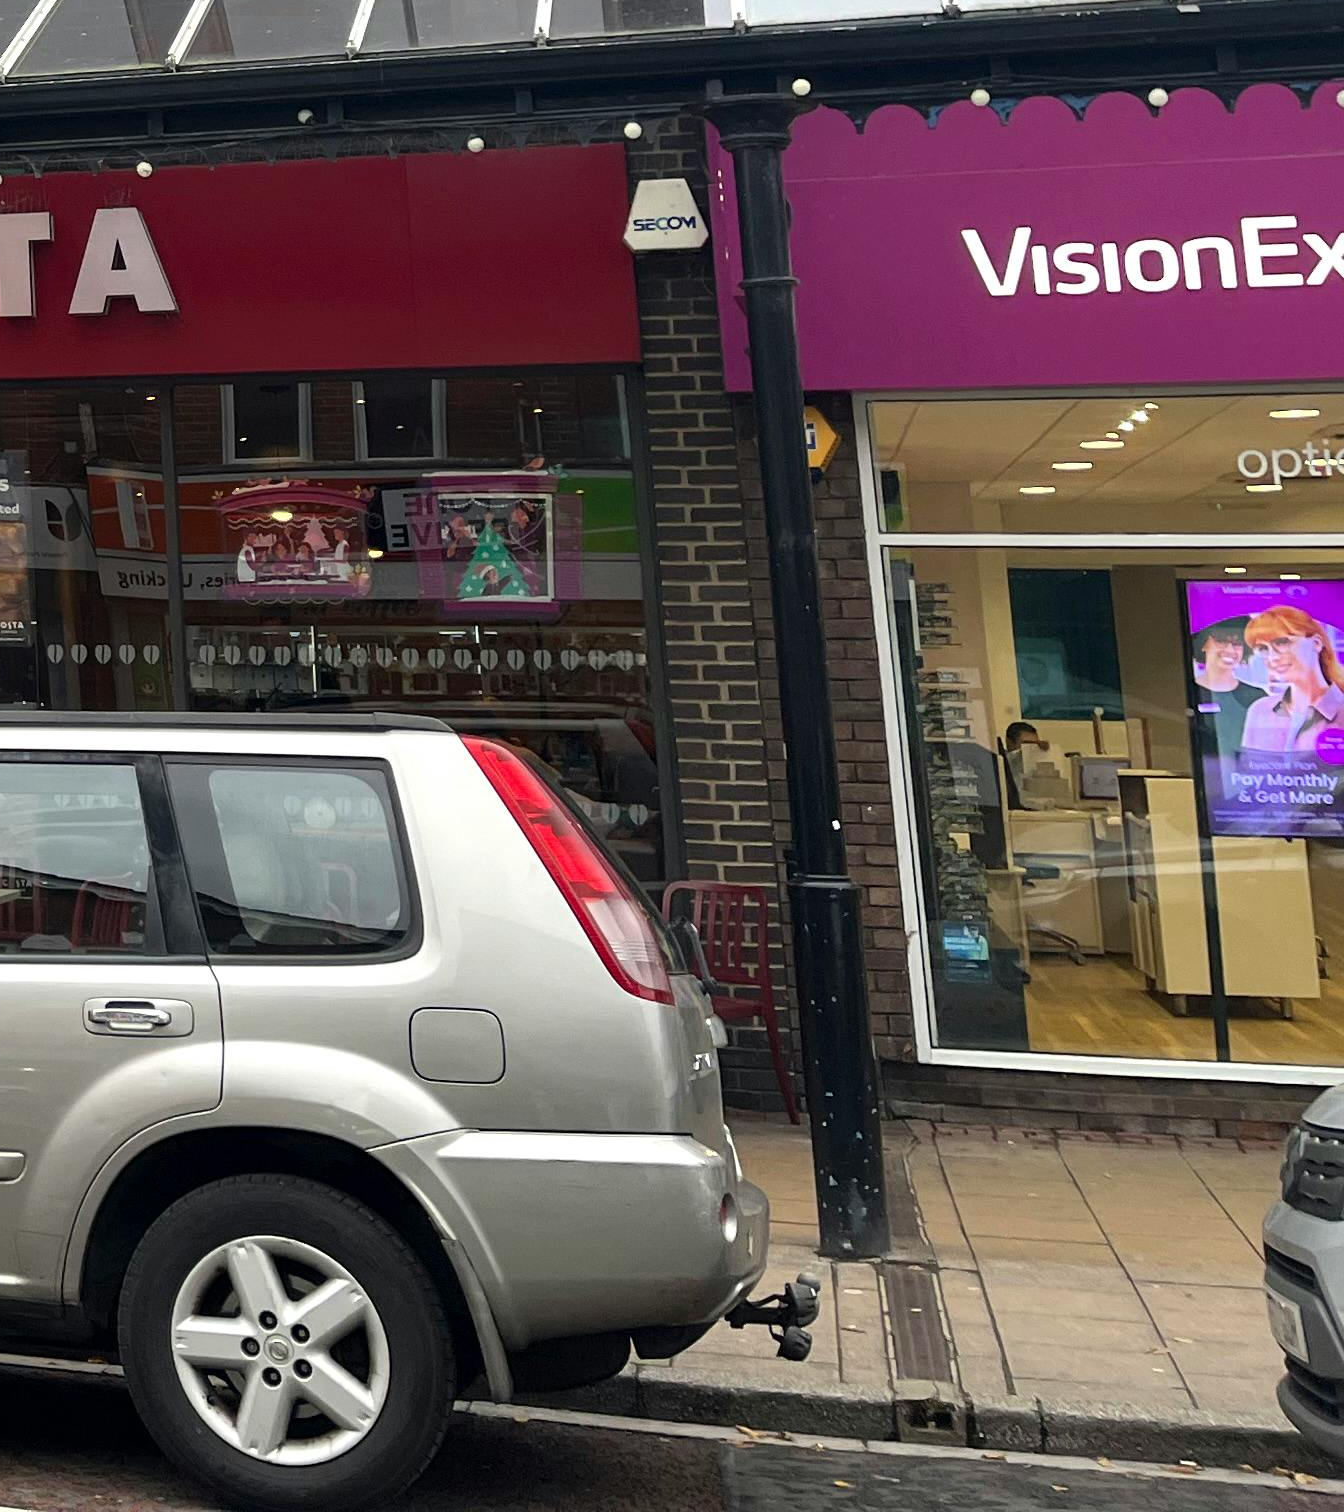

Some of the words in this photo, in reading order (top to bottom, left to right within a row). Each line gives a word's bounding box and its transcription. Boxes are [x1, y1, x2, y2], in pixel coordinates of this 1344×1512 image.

[633, 216, 697, 231] SECOM
[1231, 772, 1263, 790] Pay
[1267, 772, 1339, 791] Monthly
[1238, 791, 1252, 804] &
[1255, 790, 1287, 804] Get
[1289, 791, 1335, 806] More
